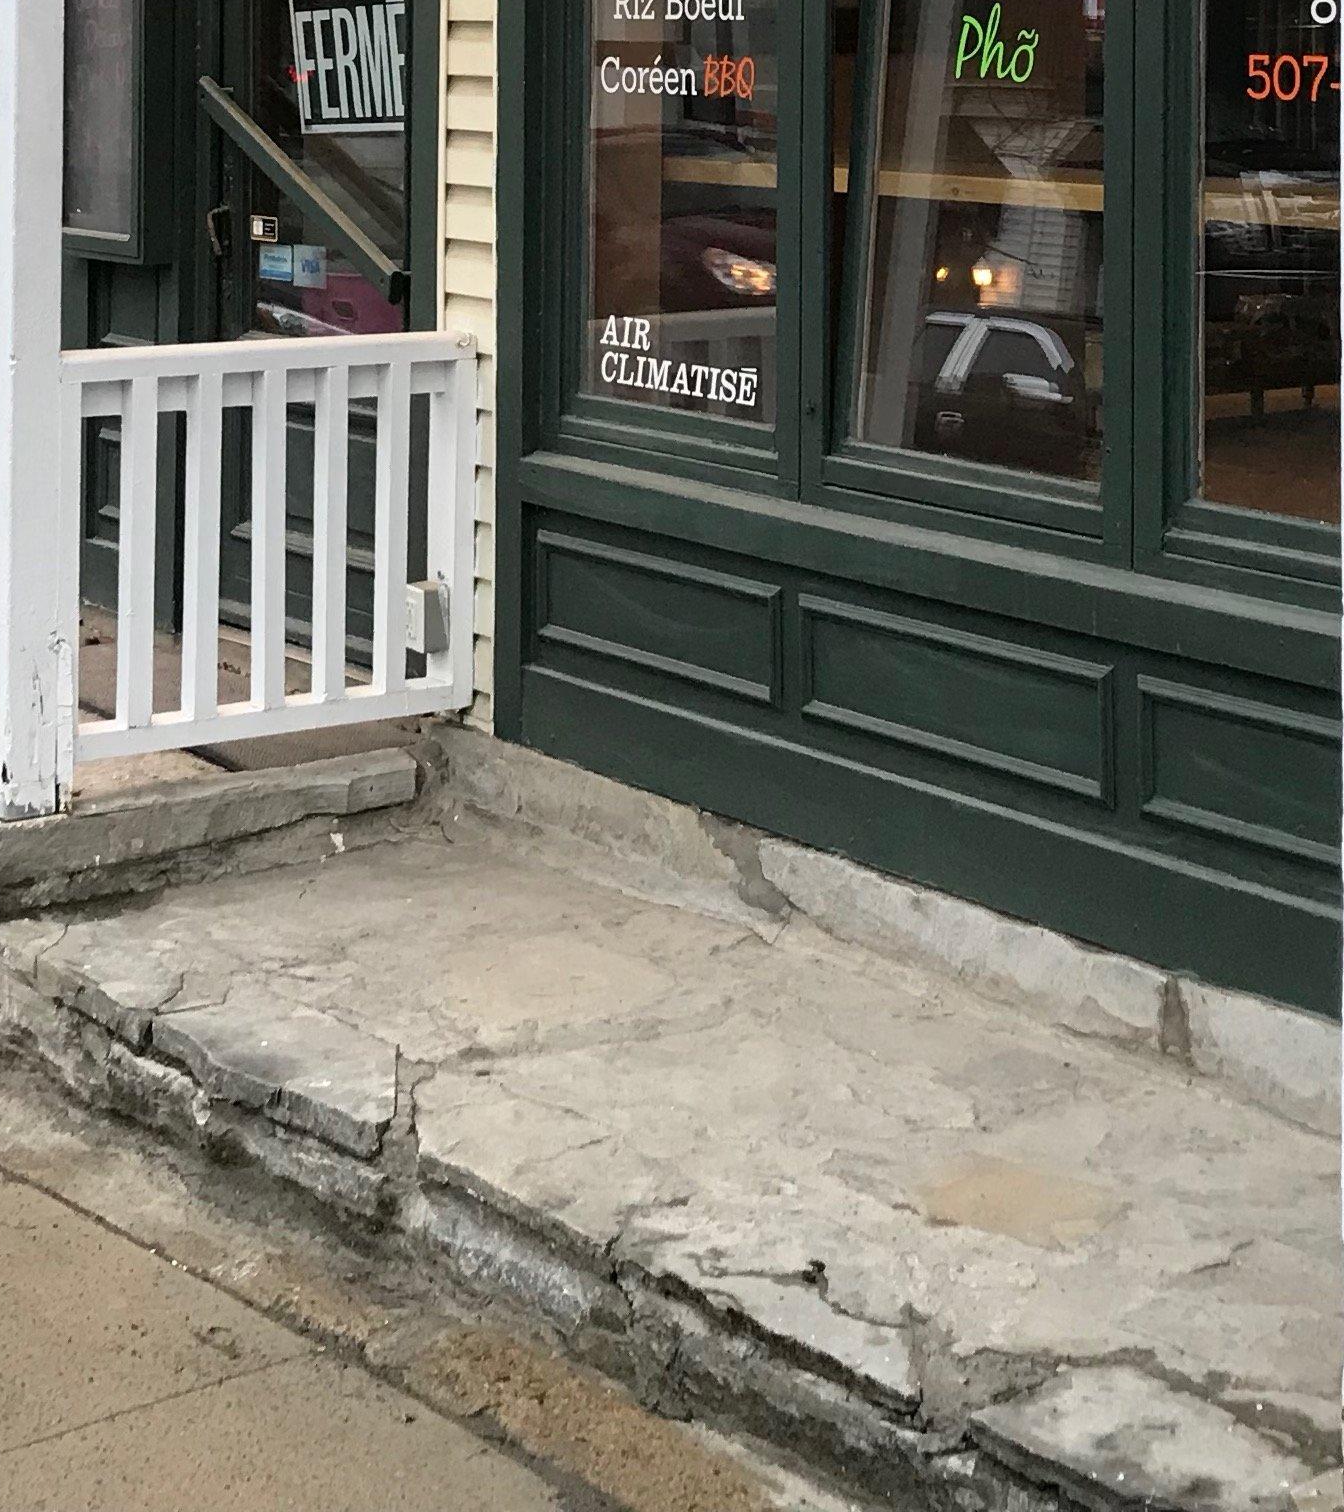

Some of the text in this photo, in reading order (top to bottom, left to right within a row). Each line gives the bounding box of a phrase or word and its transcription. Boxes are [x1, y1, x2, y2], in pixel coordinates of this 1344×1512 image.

[600, 54, 755, 101] Coréen BBQ
[599, 314, 651, 352] AIR
